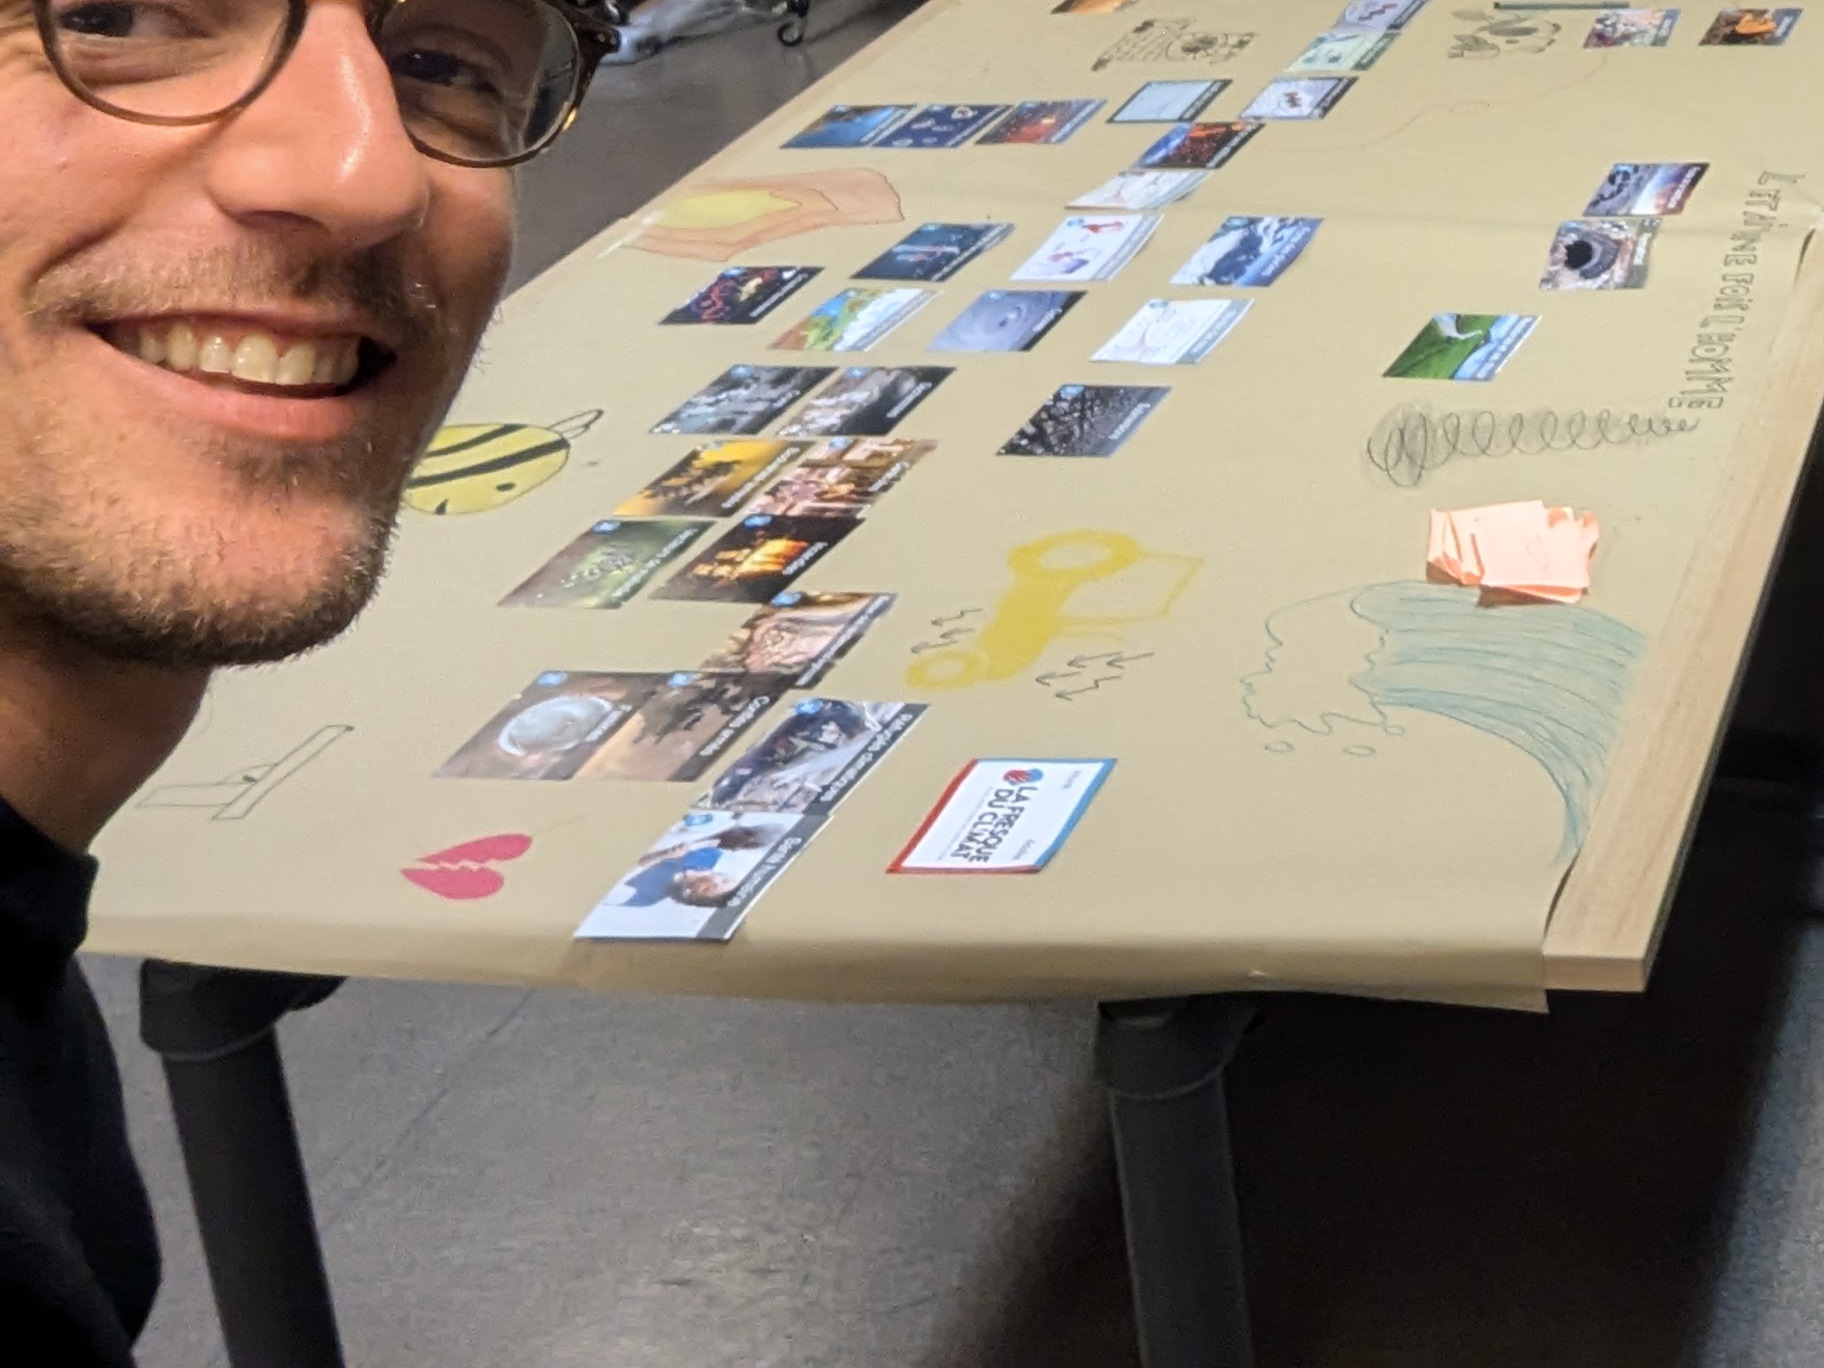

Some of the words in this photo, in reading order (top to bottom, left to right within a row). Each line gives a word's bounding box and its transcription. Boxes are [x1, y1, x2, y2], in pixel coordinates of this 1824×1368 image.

[985, 788, 1016, 809] DU
[1010, 786, 1040, 803] LA
[949, 811, 1000, 859] CLIMAT
[968, 805, 1026, 862] FRESQUE
